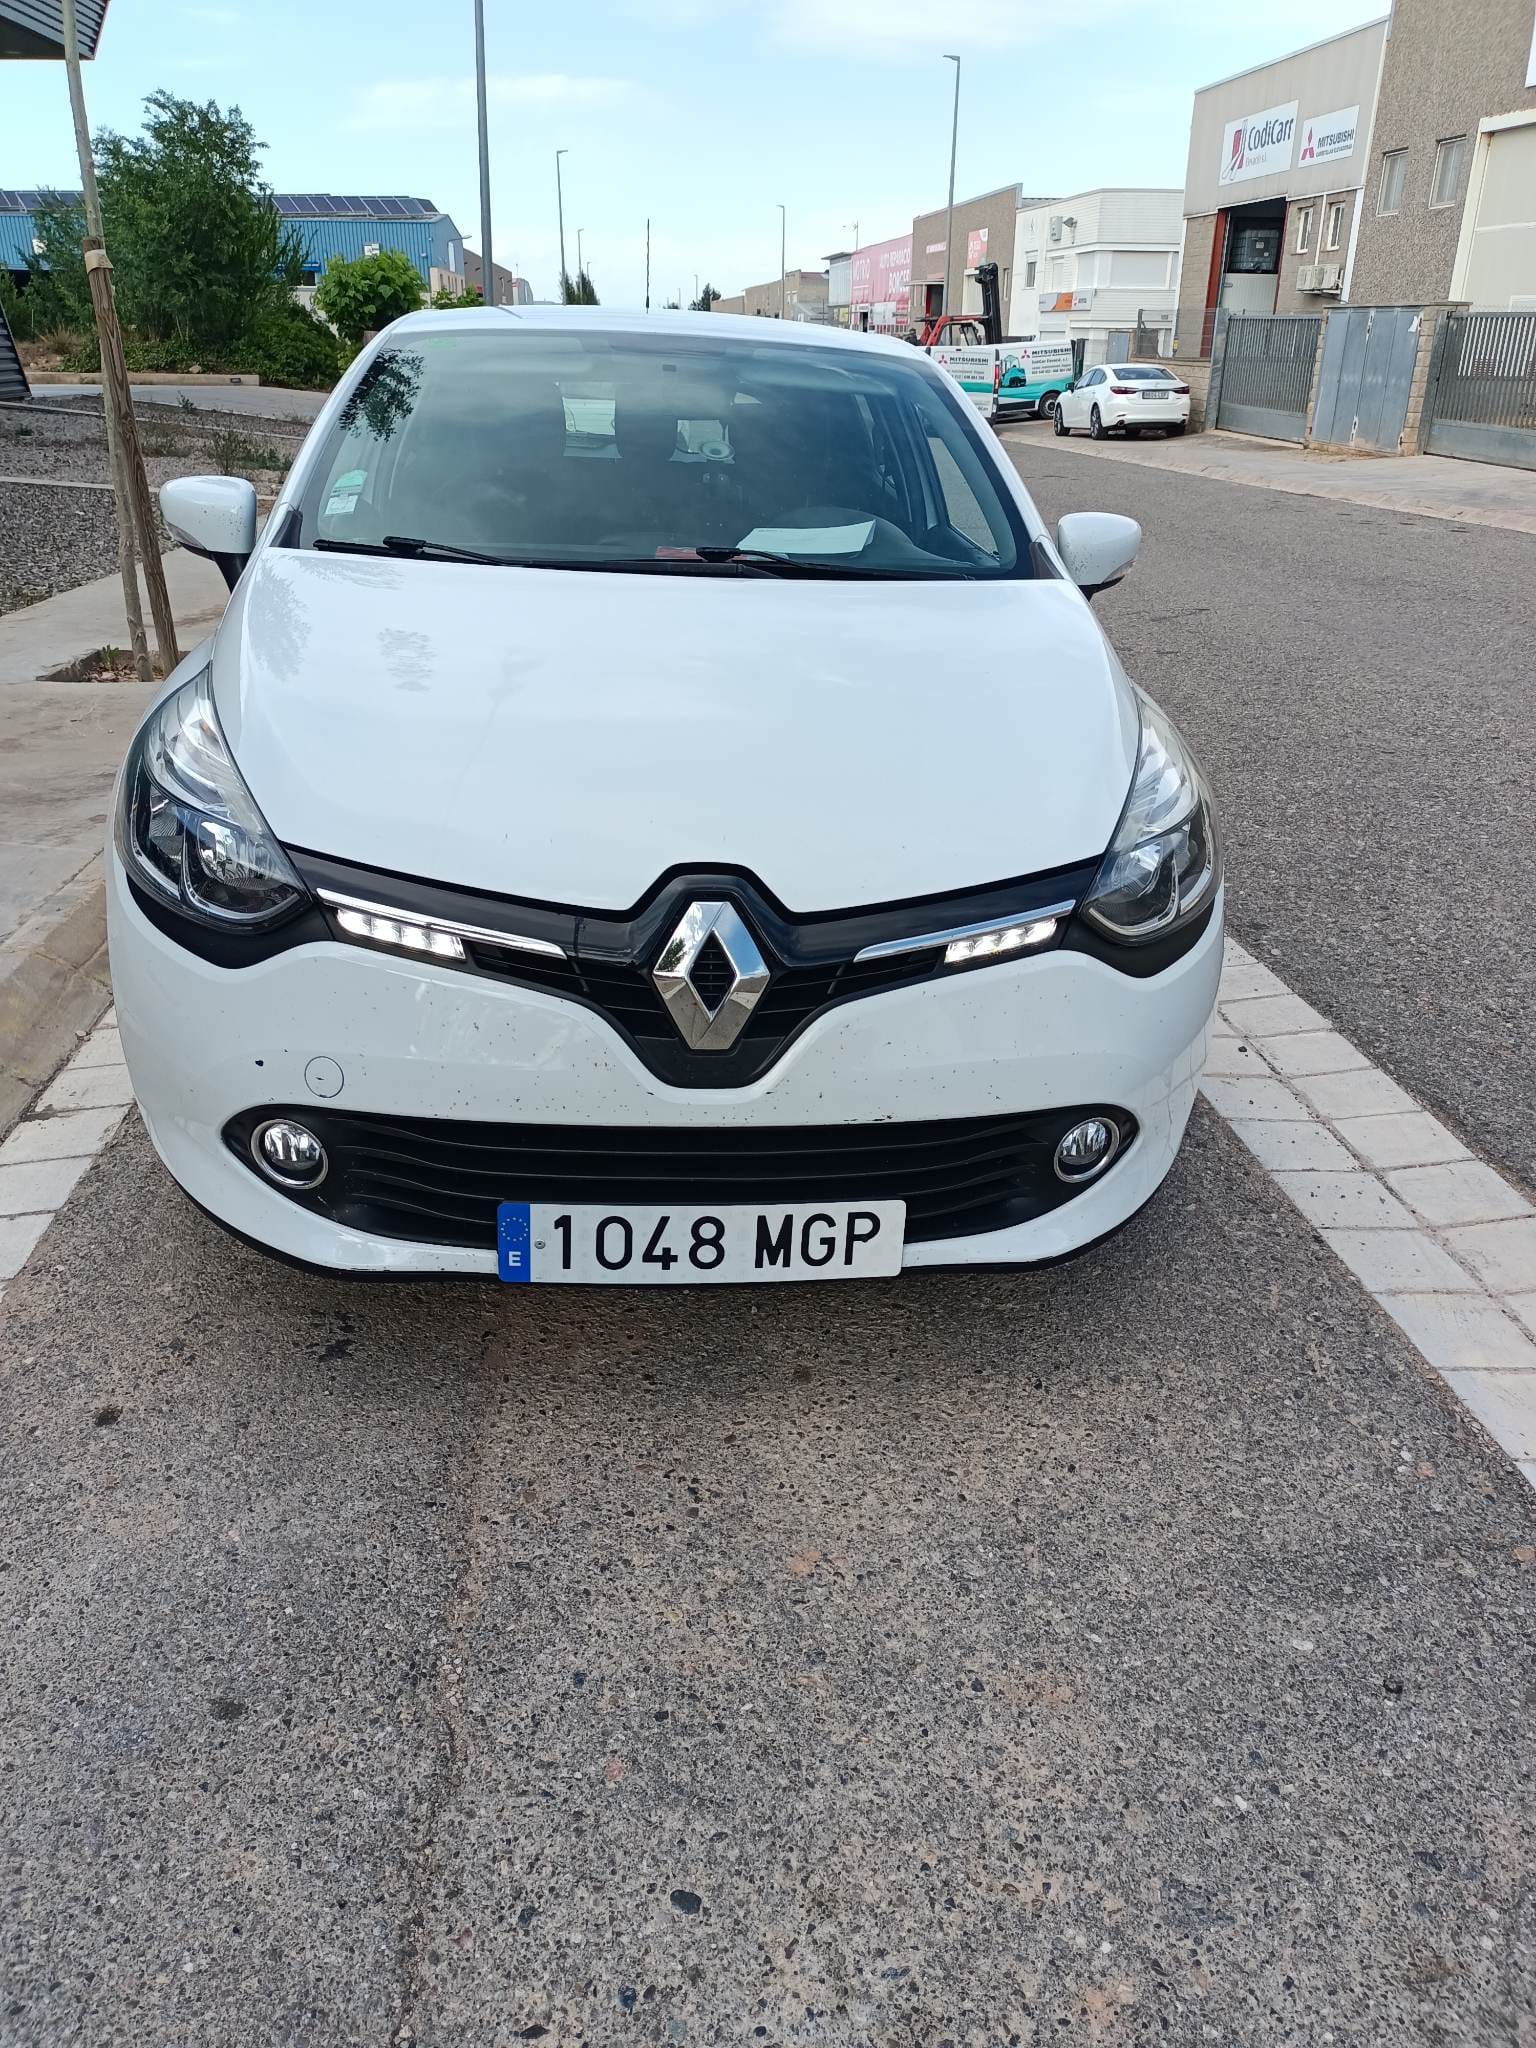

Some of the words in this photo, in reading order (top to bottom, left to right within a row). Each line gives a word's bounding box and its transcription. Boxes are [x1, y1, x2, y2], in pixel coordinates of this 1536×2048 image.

[1248, 117, 1294, 151] CodiCarr
[1317, 128, 1355, 149] MITSUBISHI
[1031, 348, 1072, 356] MITSUBISHI
[554, 1214, 726, 1271] 1048
[754, 1211, 881, 1269] MGP
[508, 1251, 522, 1267] E
